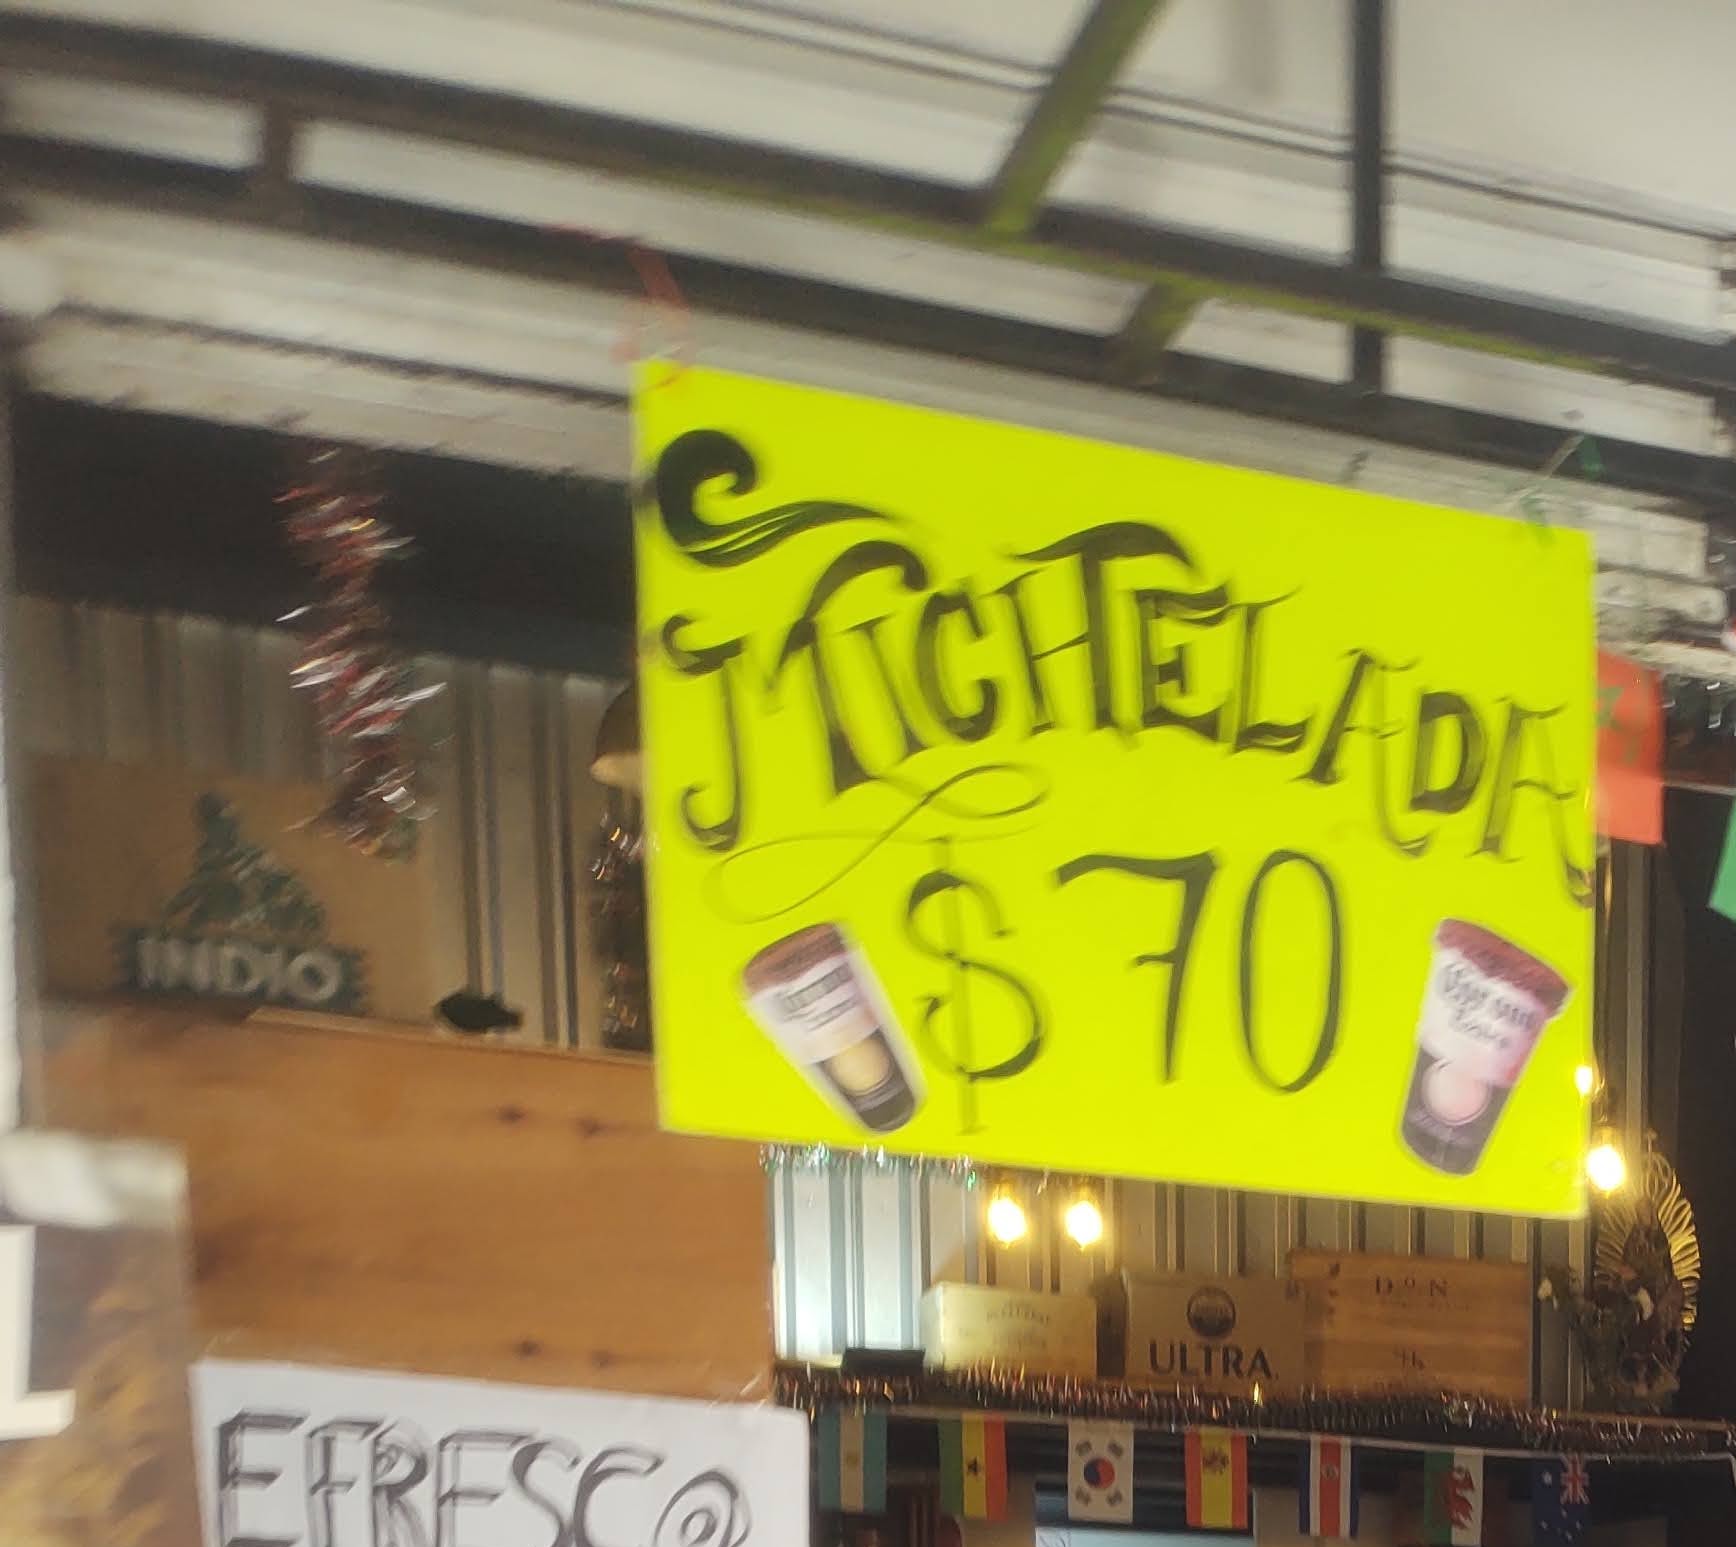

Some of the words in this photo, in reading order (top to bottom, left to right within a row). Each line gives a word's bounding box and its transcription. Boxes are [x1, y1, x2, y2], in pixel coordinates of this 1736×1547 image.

[658, 522, 1597, 910] MICHELADA
[137, 936, 346, 1001] INDIO
[1149, 1338, 1275, 1379] ULTRA
